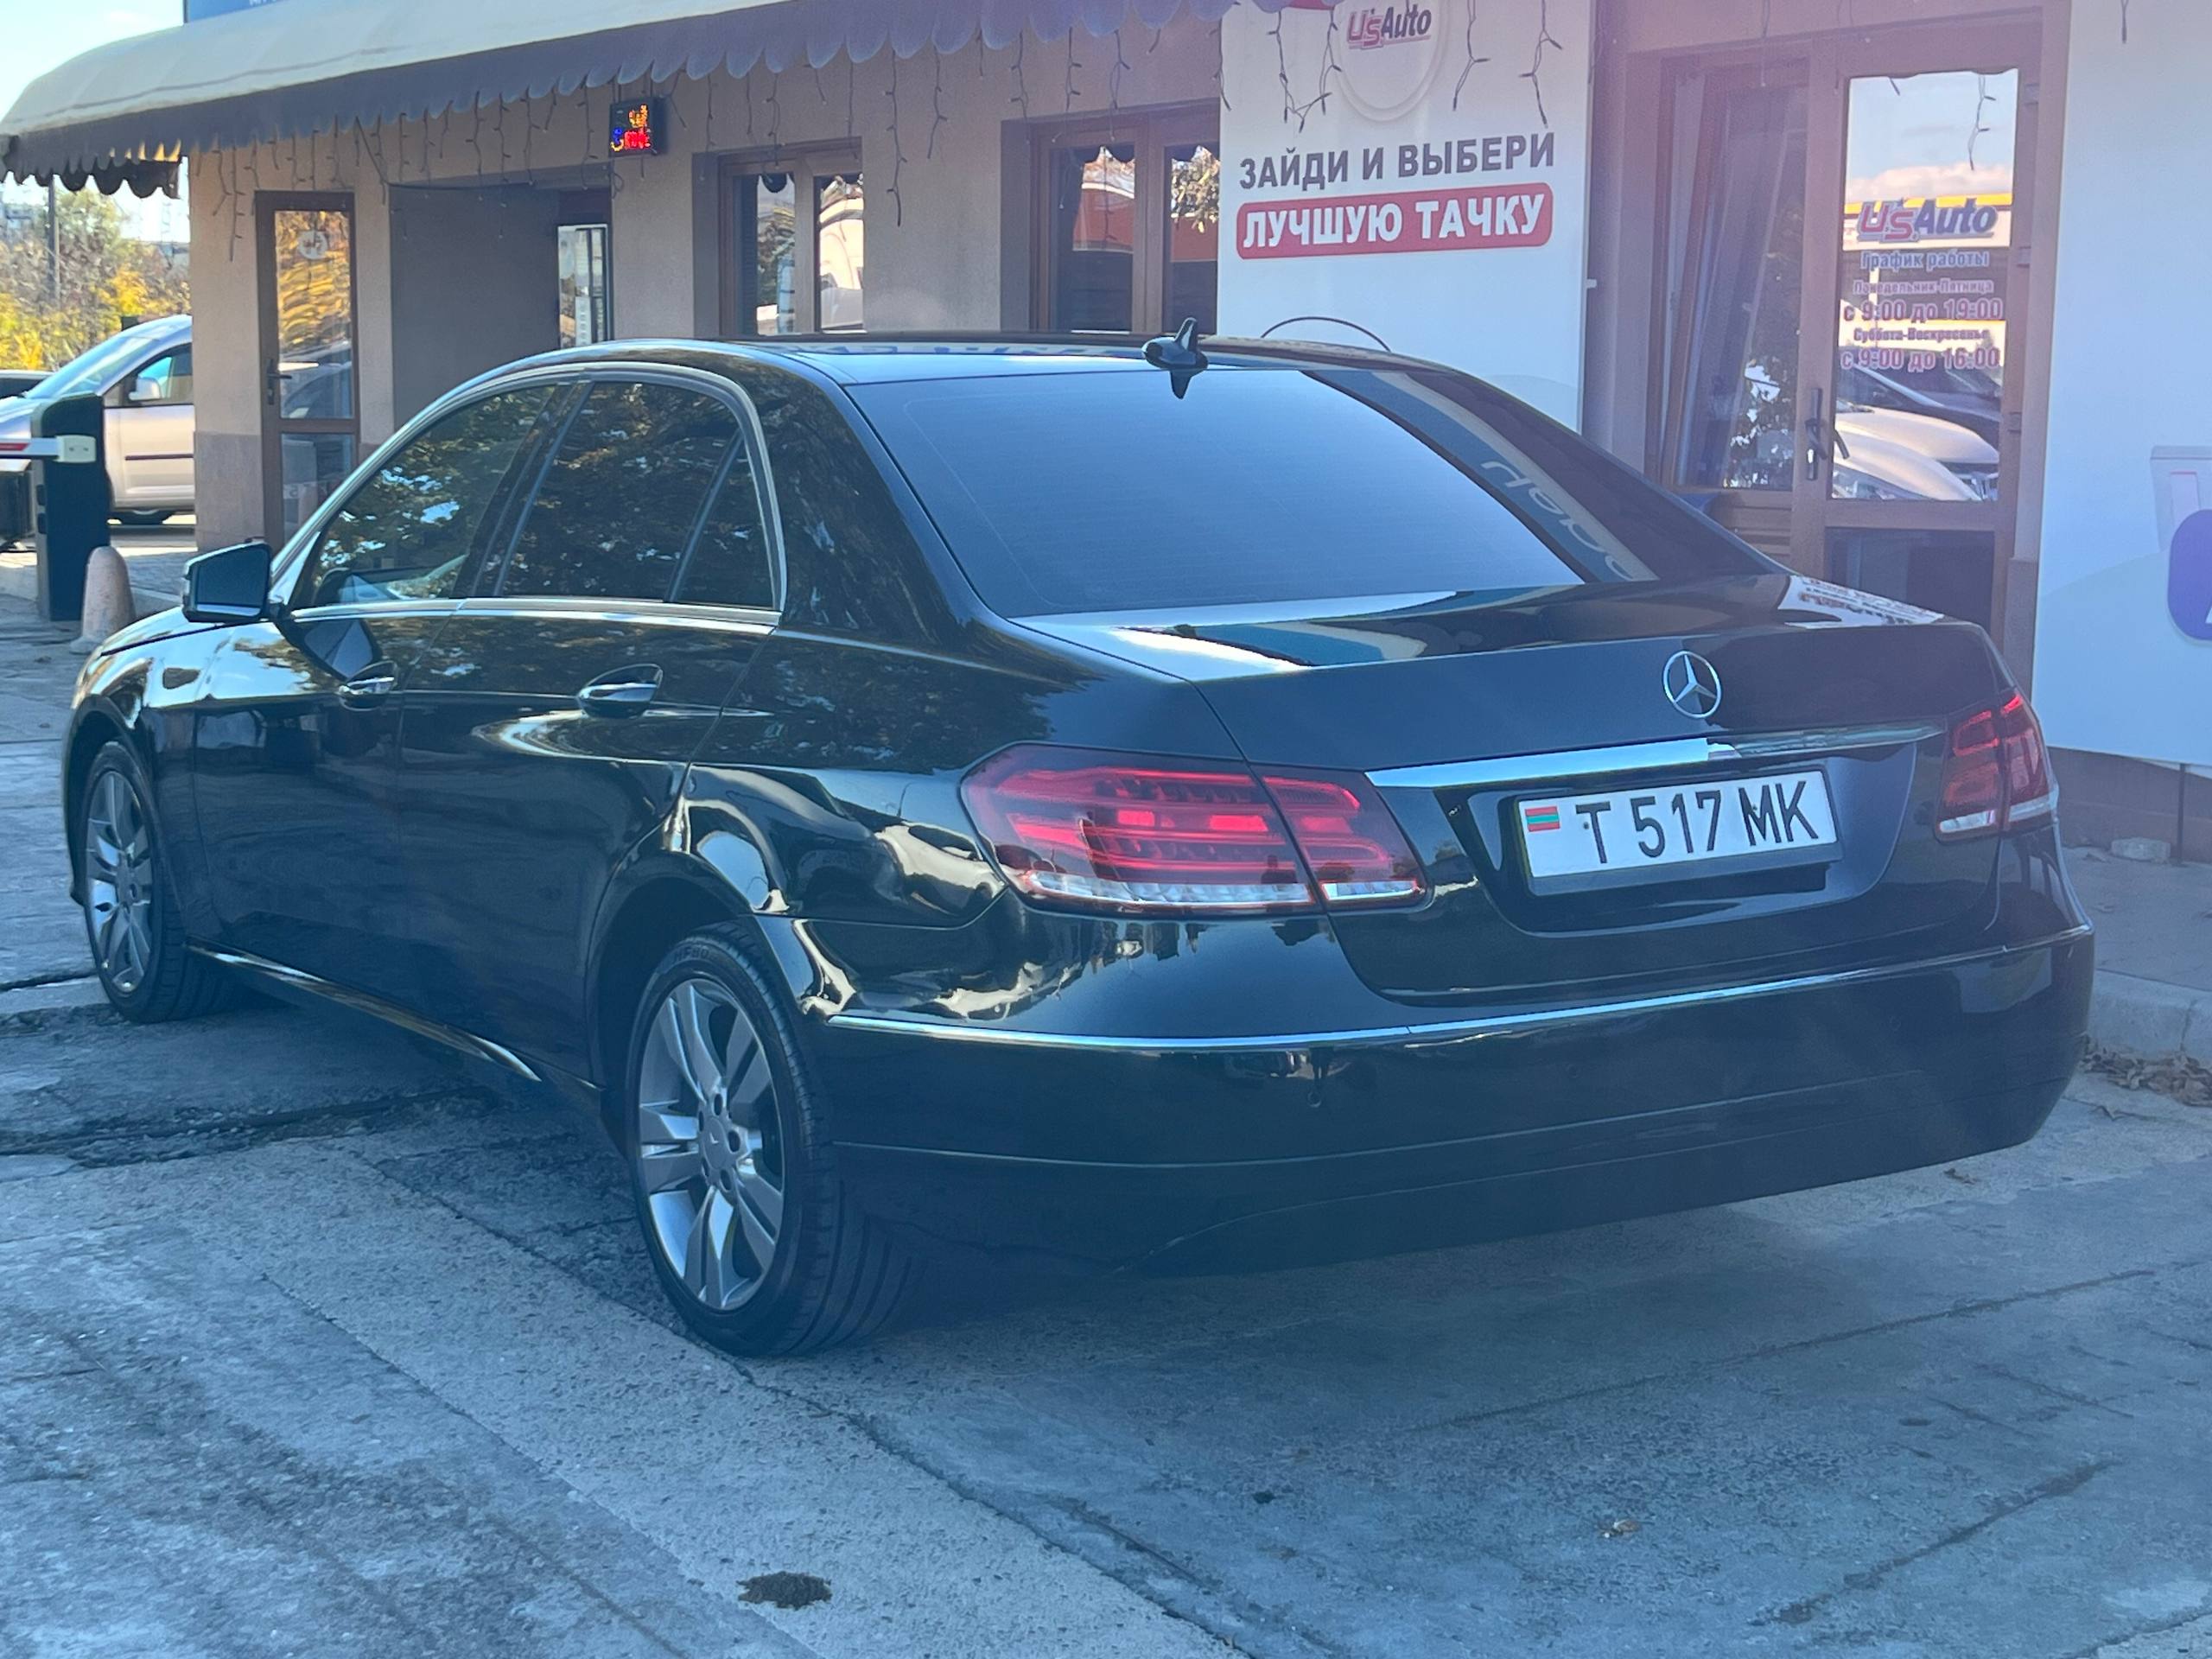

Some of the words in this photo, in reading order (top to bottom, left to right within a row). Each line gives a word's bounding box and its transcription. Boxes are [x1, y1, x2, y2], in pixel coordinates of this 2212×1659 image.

[1239, 147, 1348, 191] ЗАЙДИ
[1362, 147, 1384, 180] И
[1397, 132, 1554, 178] ВЫБЕРИ
[1243, 202, 1403, 249] ЛУЧШУЮ
[1414, 193, 1545, 239] ТАЧКУ
[1860, 250, 1923, 272] График
[1926, 247, 1990, 271] работы
[1843, 305, 1855, 321] с
[1861, 299, 1906, 321] 9:00
[1910, 304, 1937, 323] до
[1944, 298, 2003, 320] 19:00
[1840, 352, 1854, 370] с
[1859, 347, 1904, 370] 9:00
[1908, 351, 1936, 372] до
[1942, 346, 2001, 370] 16:00
[1575, 801, 1611, 863] T
[1630, 790, 1721, 858] 517
[1738, 780, 1819, 846] MK
